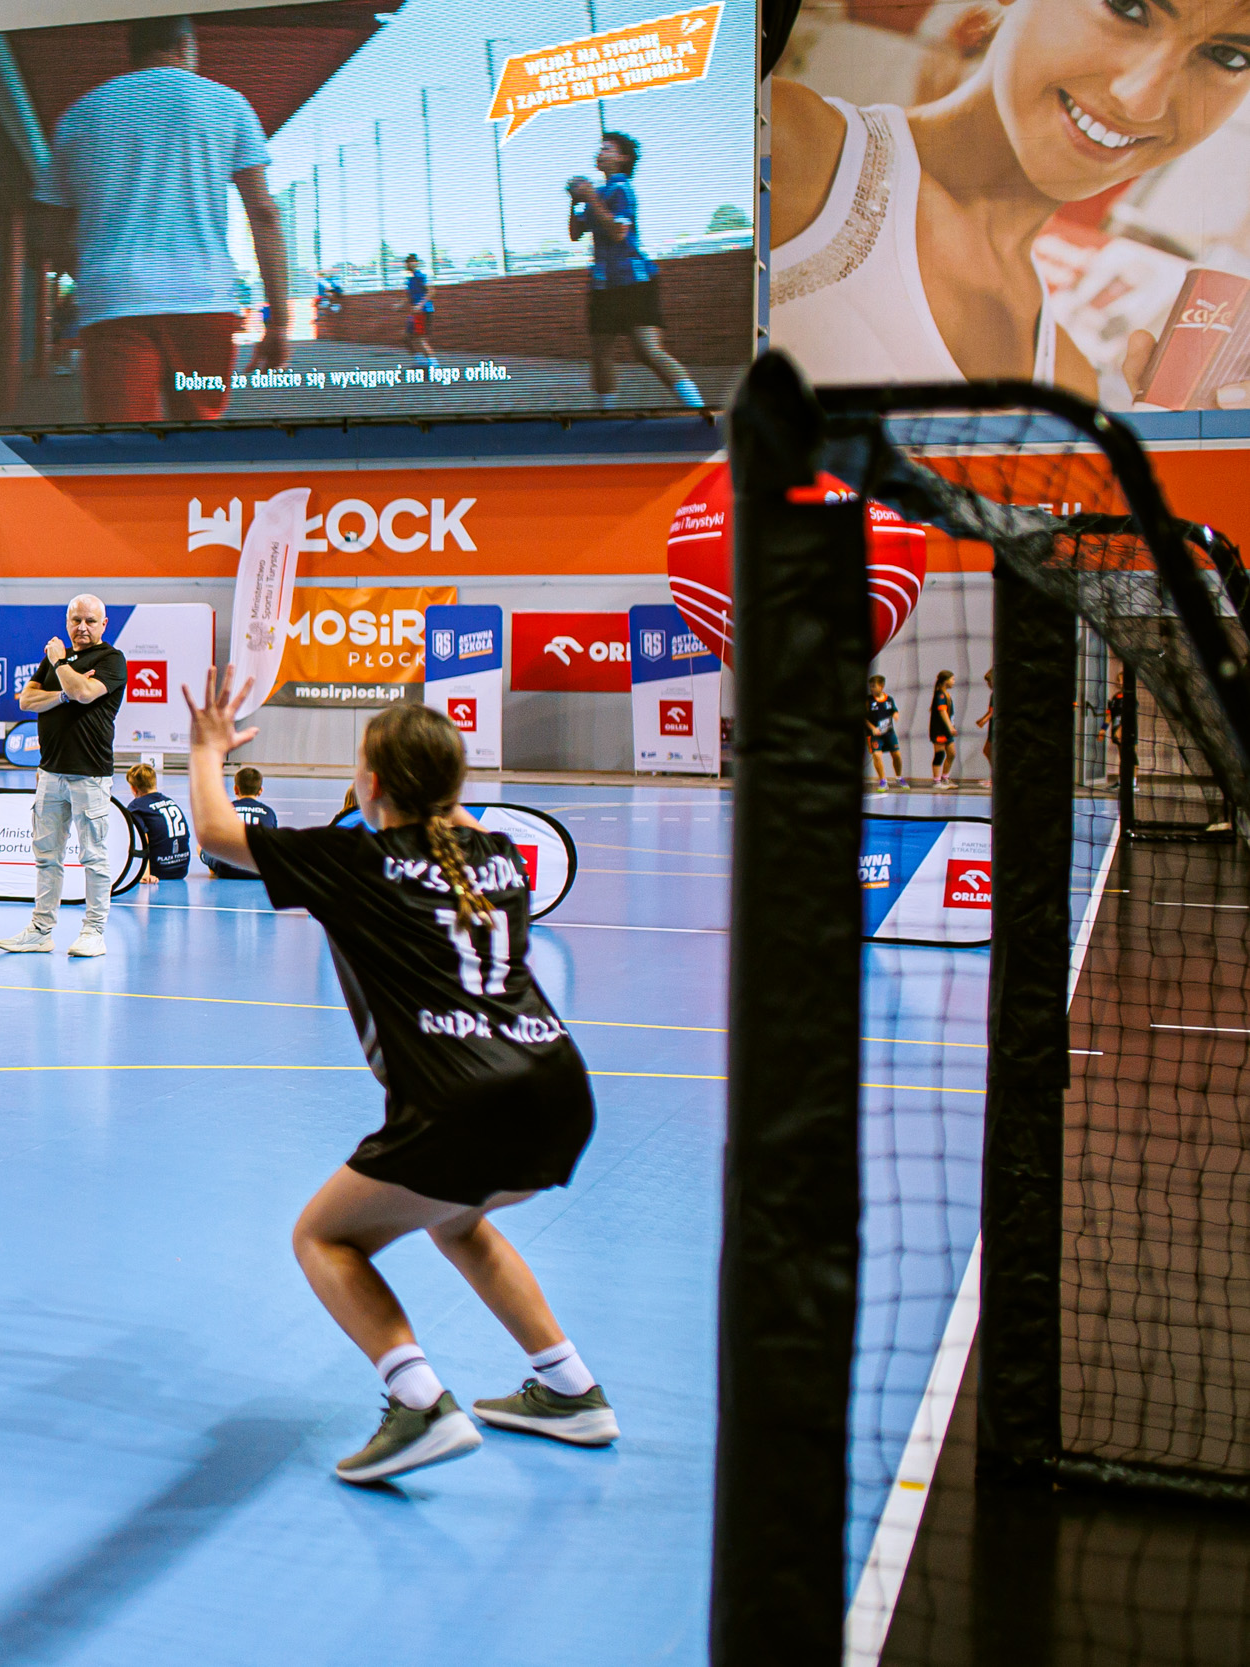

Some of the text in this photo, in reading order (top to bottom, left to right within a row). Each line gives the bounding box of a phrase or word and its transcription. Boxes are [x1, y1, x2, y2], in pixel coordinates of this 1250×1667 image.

[576, 47, 601, 64] NA
[516, 85, 570, 109] ZAPISZ
[597, 73, 621, 91] NA
[1181, 301, 1232, 333] cafe
[305, 369, 326, 389] się
[405, 369, 424, 383] na
[464, 361, 512, 382] orlika.
[254, 497, 478, 553] ŁOCK
[685, 512, 725, 530] Turystyki
[266, 541, 280, 582] Turystyki
[250, 559, 266, 619] Ministerstwo
[286, 608, 426, 647] MOSiR
[349, 652, 426, 668] PŁOCK
[458, 639, 493, 655] SZKOŁA
[131, 688, 163, 698] ORLEN
[295, 684, 406, 702] mosirplock.pl
[664, 723, 689, 731] ORLEN
[159, 805, 186, 838] 12
